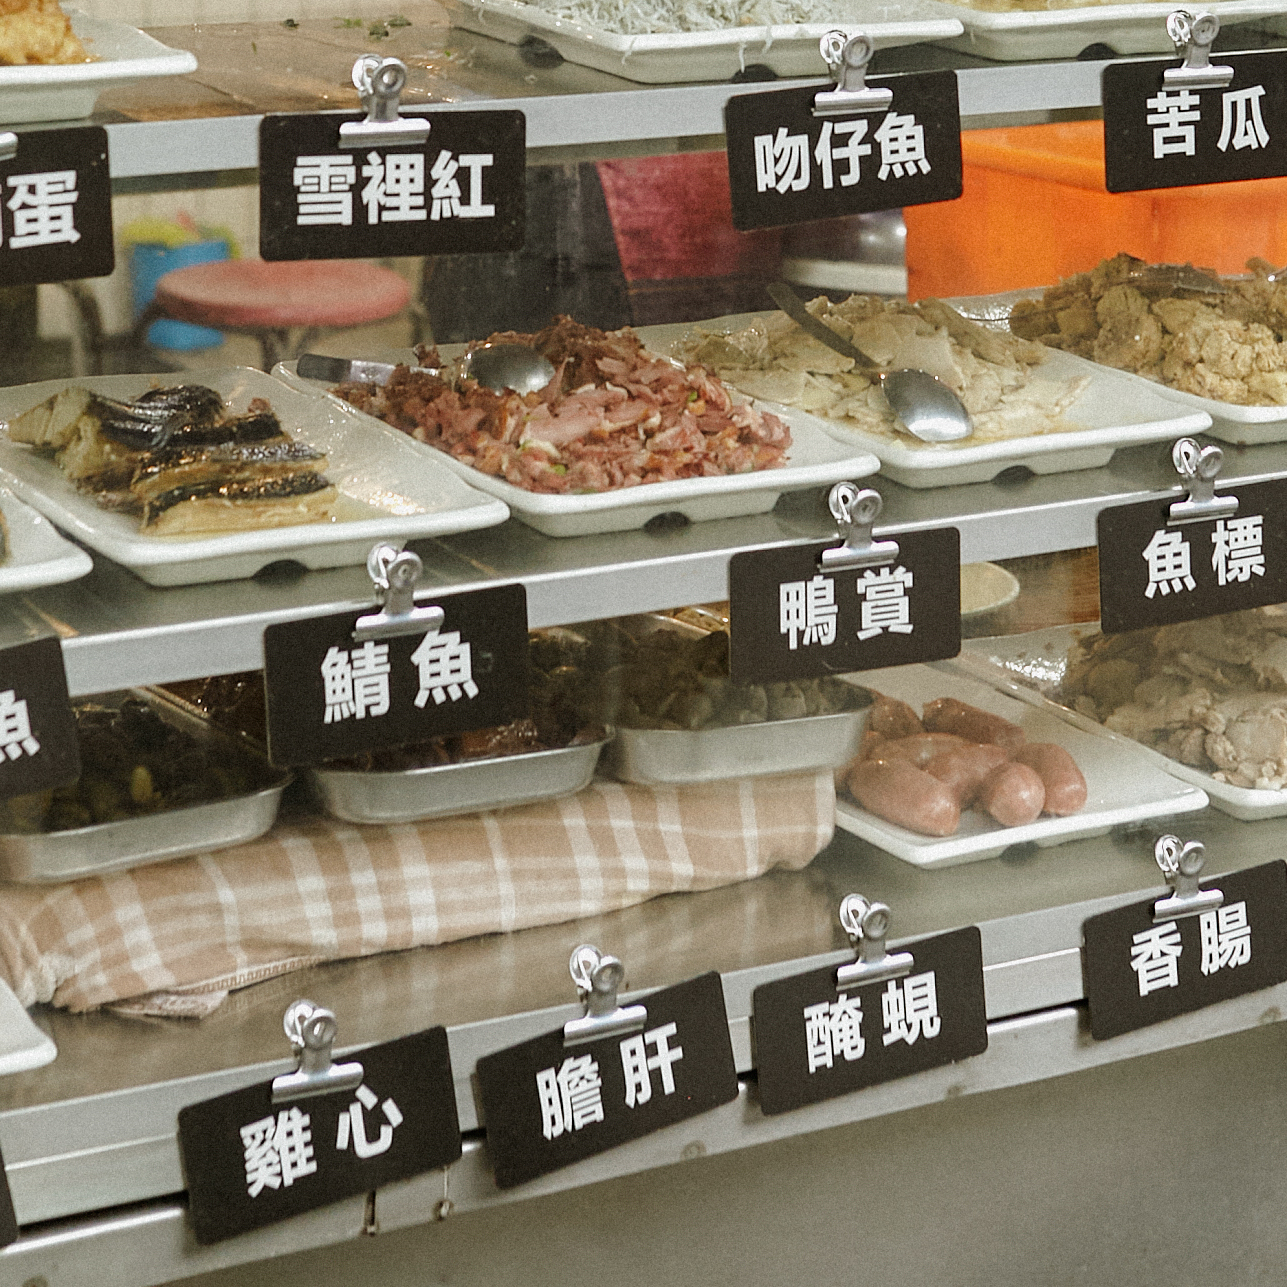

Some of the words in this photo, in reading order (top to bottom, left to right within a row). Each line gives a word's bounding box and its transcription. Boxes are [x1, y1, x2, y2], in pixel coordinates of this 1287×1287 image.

[754, 113, 931, 194] 吻仔魚
[1146, 85, 1270, 159] 苦瓜
[293, 150, 496, 226] 雪裡紅
[1141, 515, 1266, 599] 魚標
[779, 565, 913, 650] 鴨賞
[320, 630, 479, 724] 鯖魚
[1130, 902, 1252, 997] 香腸
[803, 971, 941, 1074] 醃蜆
[535, 1022, 684, 1141] 膽肝
[240, 1083, 404, 1198] 雞心
